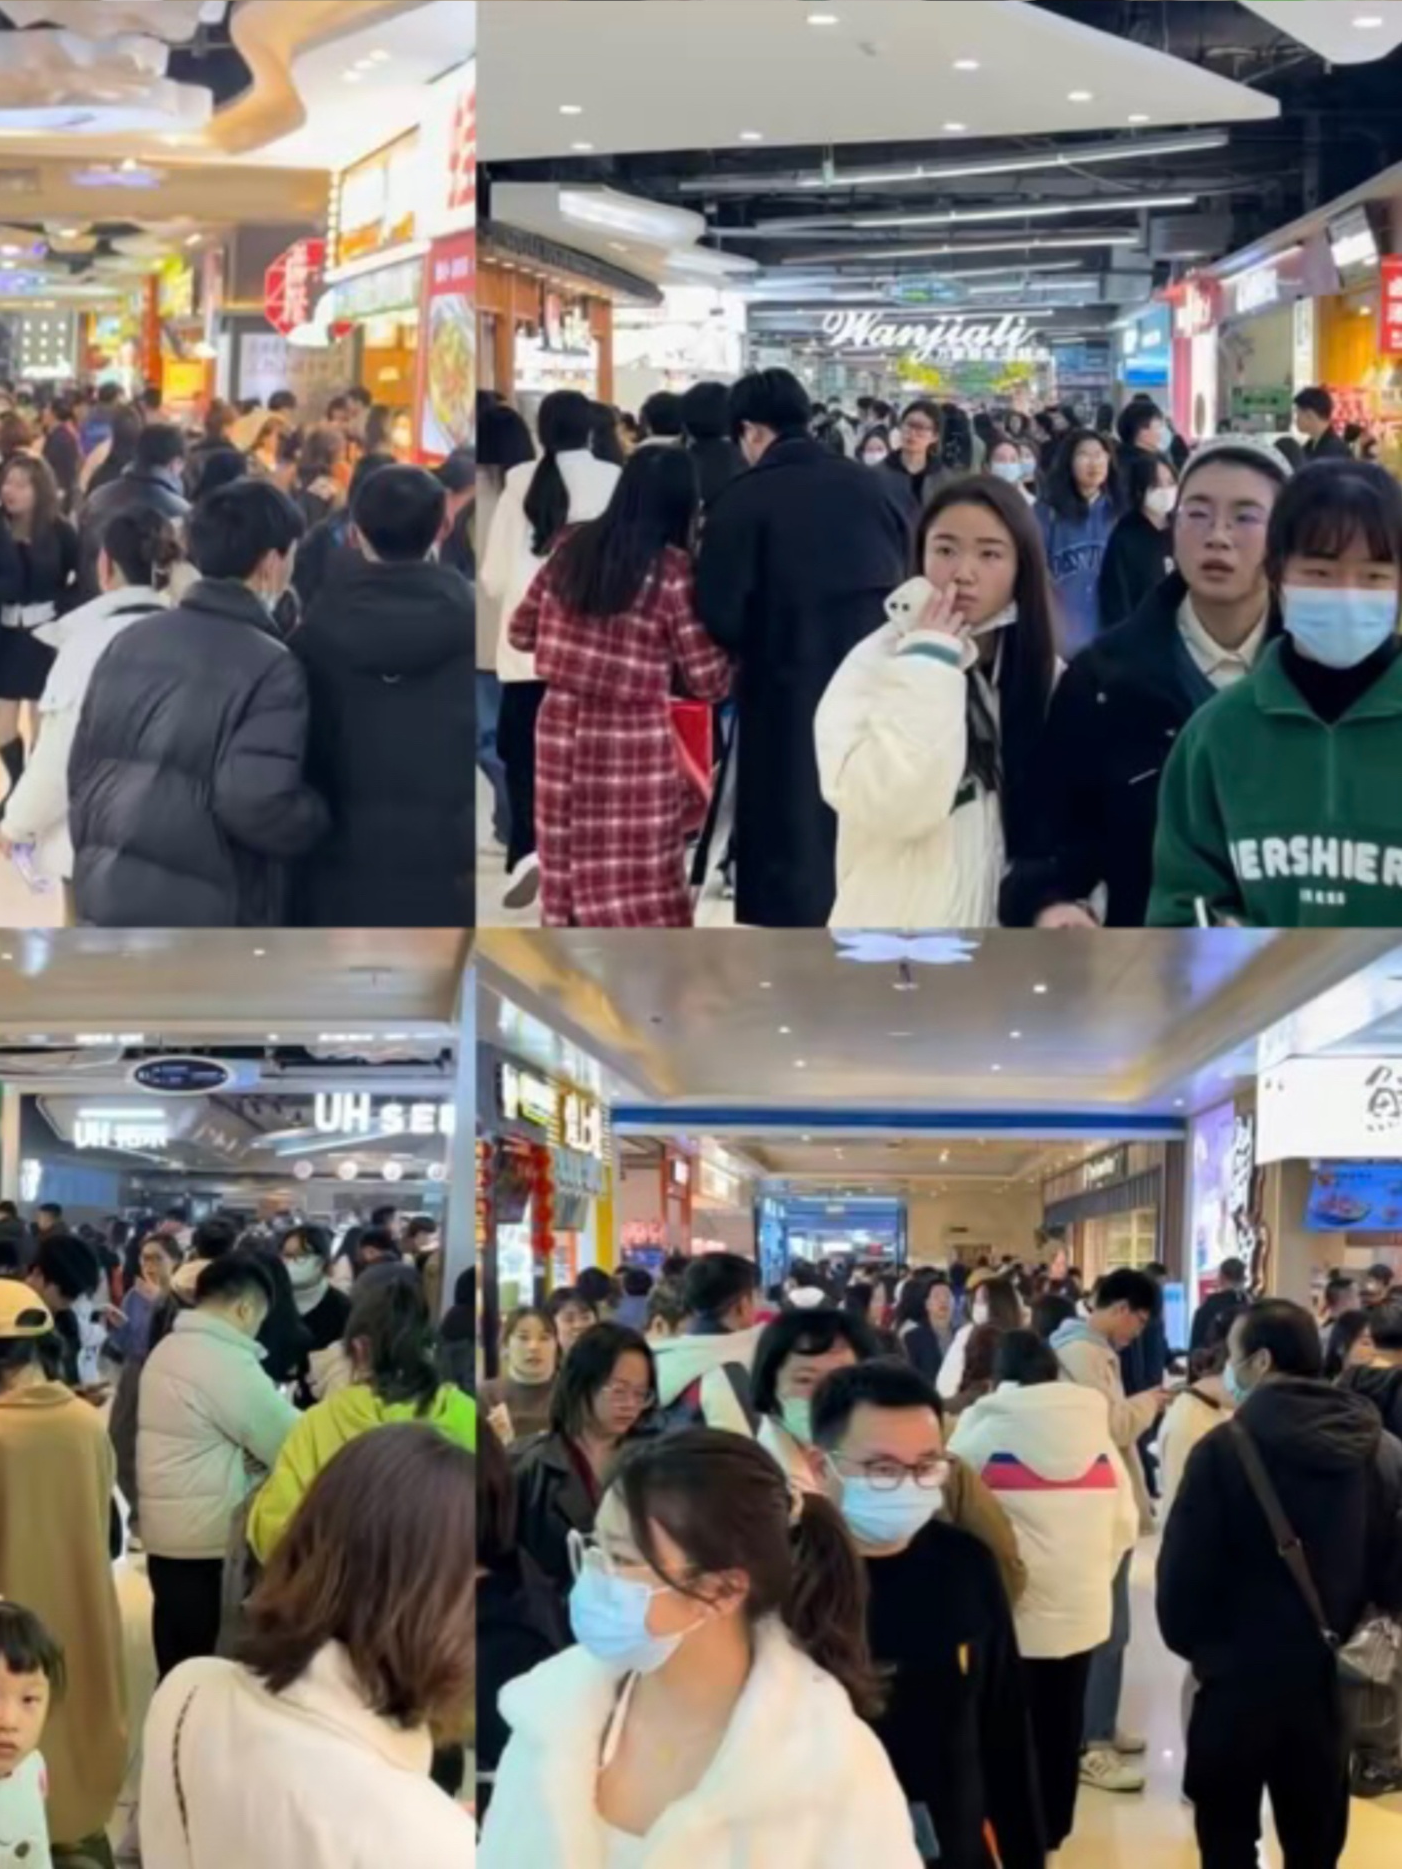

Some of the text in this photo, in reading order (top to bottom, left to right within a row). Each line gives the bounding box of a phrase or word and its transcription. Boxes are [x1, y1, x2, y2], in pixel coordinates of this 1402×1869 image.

[822, 311, 1038, 362] Wanjiali
[1229, 835, 1402, 888] ERSHIER
[315, 1092, 371, 1133] UH
